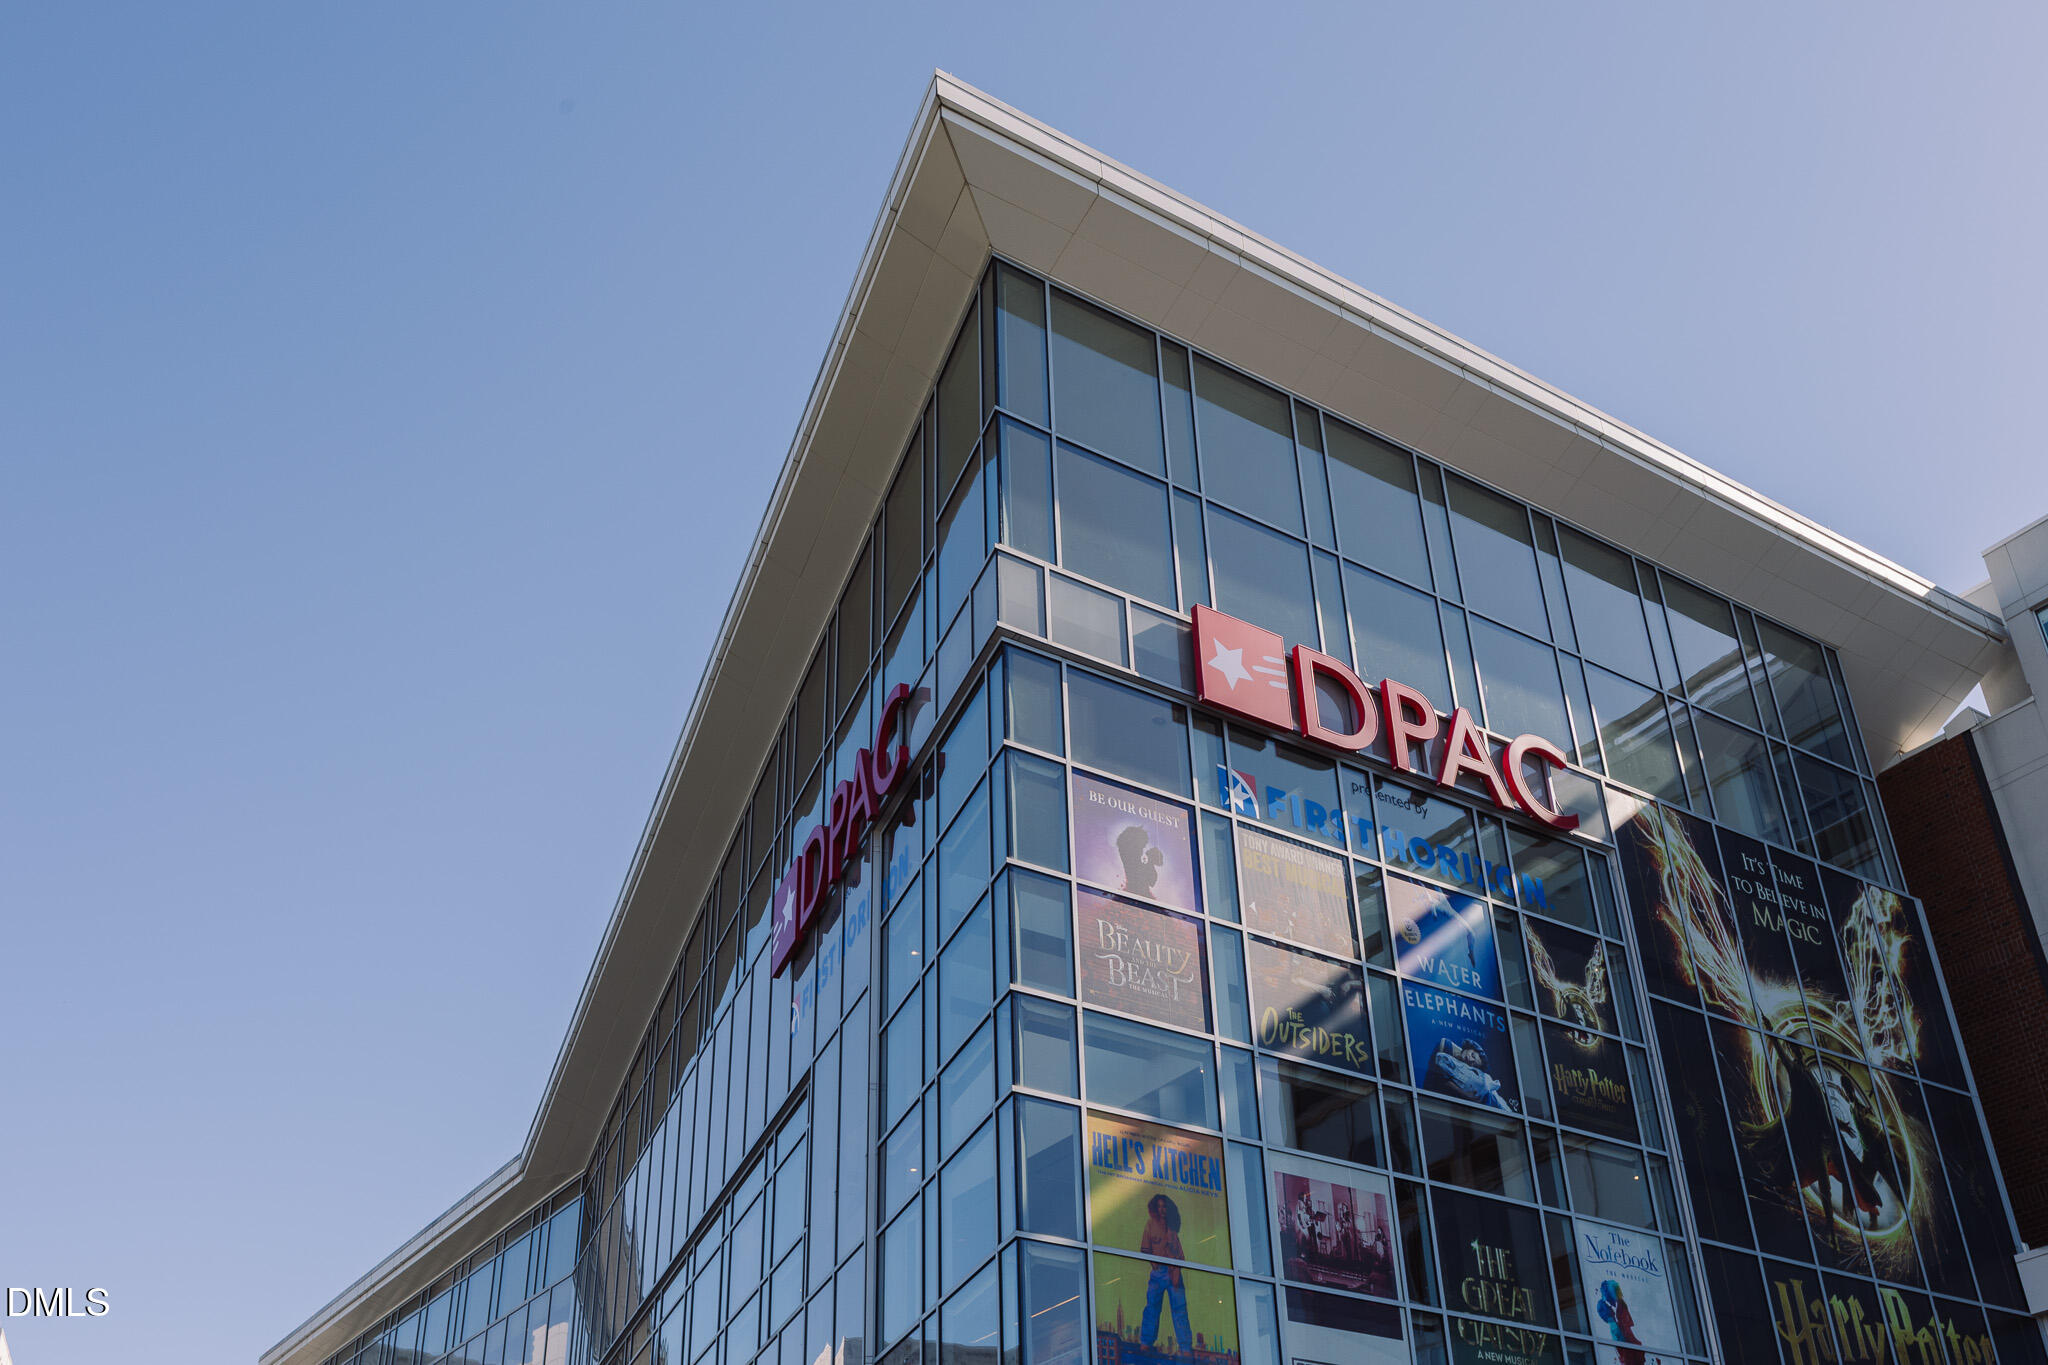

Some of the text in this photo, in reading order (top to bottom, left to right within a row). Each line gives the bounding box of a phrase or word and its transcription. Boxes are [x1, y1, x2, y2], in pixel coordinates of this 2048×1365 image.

[1292, 643, 1580, 832] DPAC
[801, 683, 910, 932] DPAC
[1088, 790, 1181, 829] BE OUR GUEST
[1265, 785, 1376, 850] FIRST
[1351, 782, 1428, 820] preented by
[1243, 847, 1281, 879] BEST
[1741, 852, 1805, 890] IT'S TIME
[1731, 875, 1826, 921] TO BELEVE IN
[1752, 901, 1822, 945] MAGIC
[1096, 918, 1192, 975] BEAUTY
[802, 941, 837, 1019] FIST
[1096, 953, 1194, 1001] BEAST
[1417, 953, 1483, 990] WATER
[1286, 1006, 1305, 1022] THE
[1404, 989, 1506, 1033] ELEPHANTS
[1260, 1006, 1369, 1069] OUTSIDERS
[1553, 1063, 1588, 1097] Harry
[1587, 1068, 1627, 1104] Potter
[1091, 1131, 1146, 1175] HELL'S
[1151, 1143, 1222, 1192] KITCHEN
[1470, 1239, 1512, 1282] THE
[1583, 1232, 1659, 1273] Notebook
[1608, 1231, 1630, 1247] The
[1461, 1276, 1537, 1321] GREAT
[1774, 1278, 1886, 1365] Harry
[1477, 1350, 1484, 1360] A
[1484, 1351, 1503, 1363] NEW
